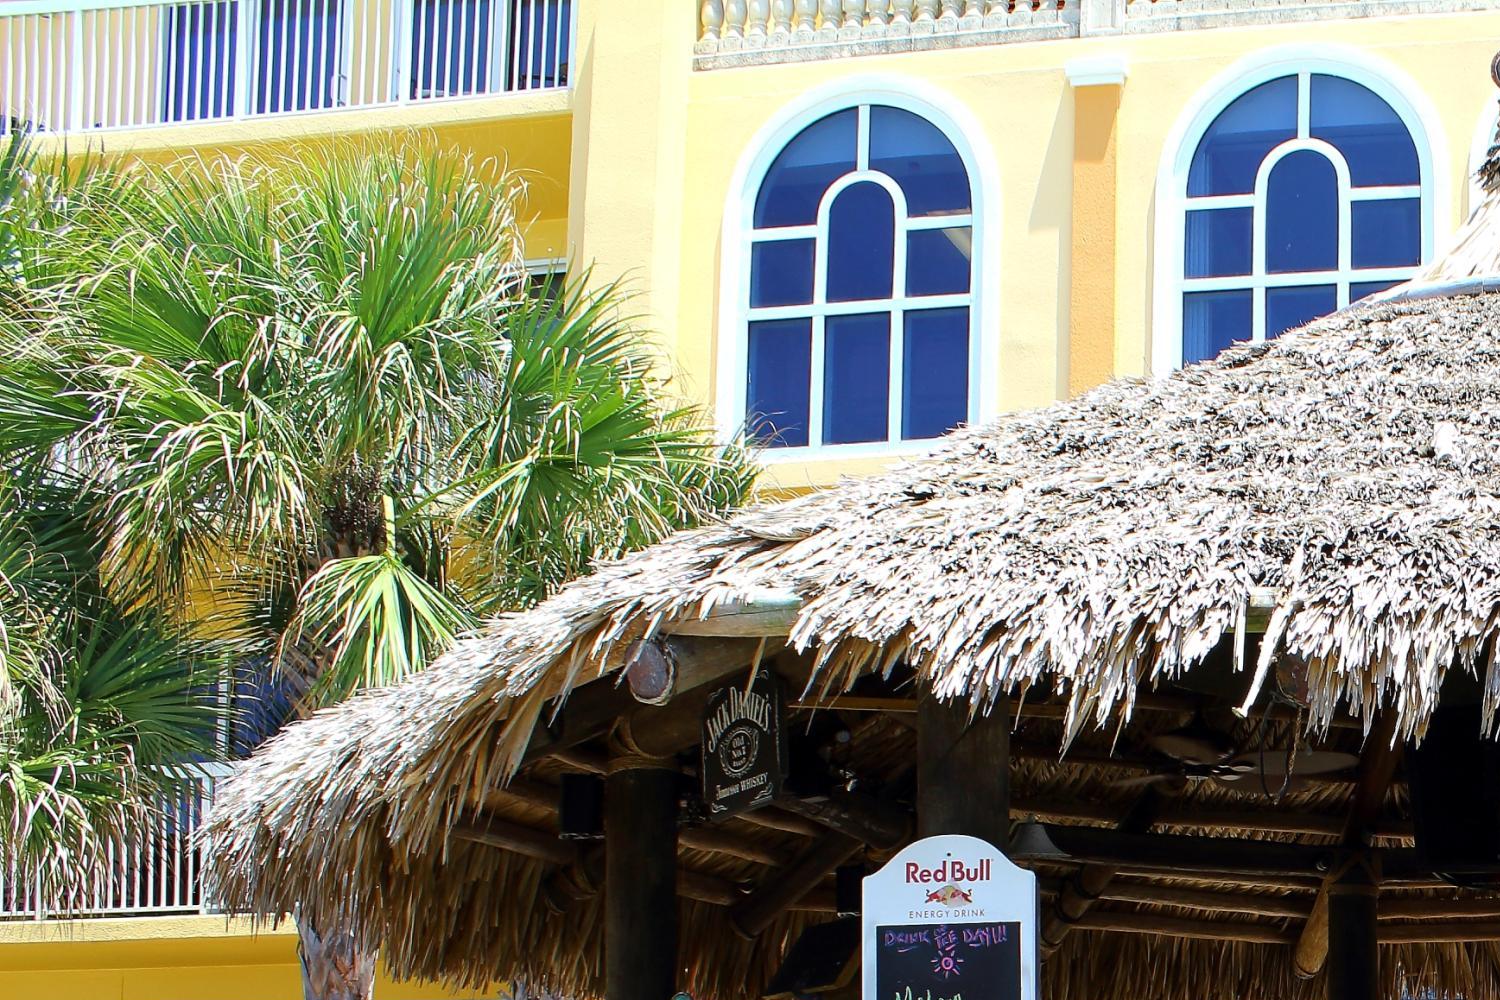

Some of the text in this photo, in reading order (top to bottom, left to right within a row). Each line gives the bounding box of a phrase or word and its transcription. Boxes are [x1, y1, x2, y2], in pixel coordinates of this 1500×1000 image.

[706, 700, 731, 753] JACK
[740, 772, 769, 792] WHISKEY
[905, 858, 992, 884] Red Bull
[908, 908, 986, 919] ENERGY DRINK
